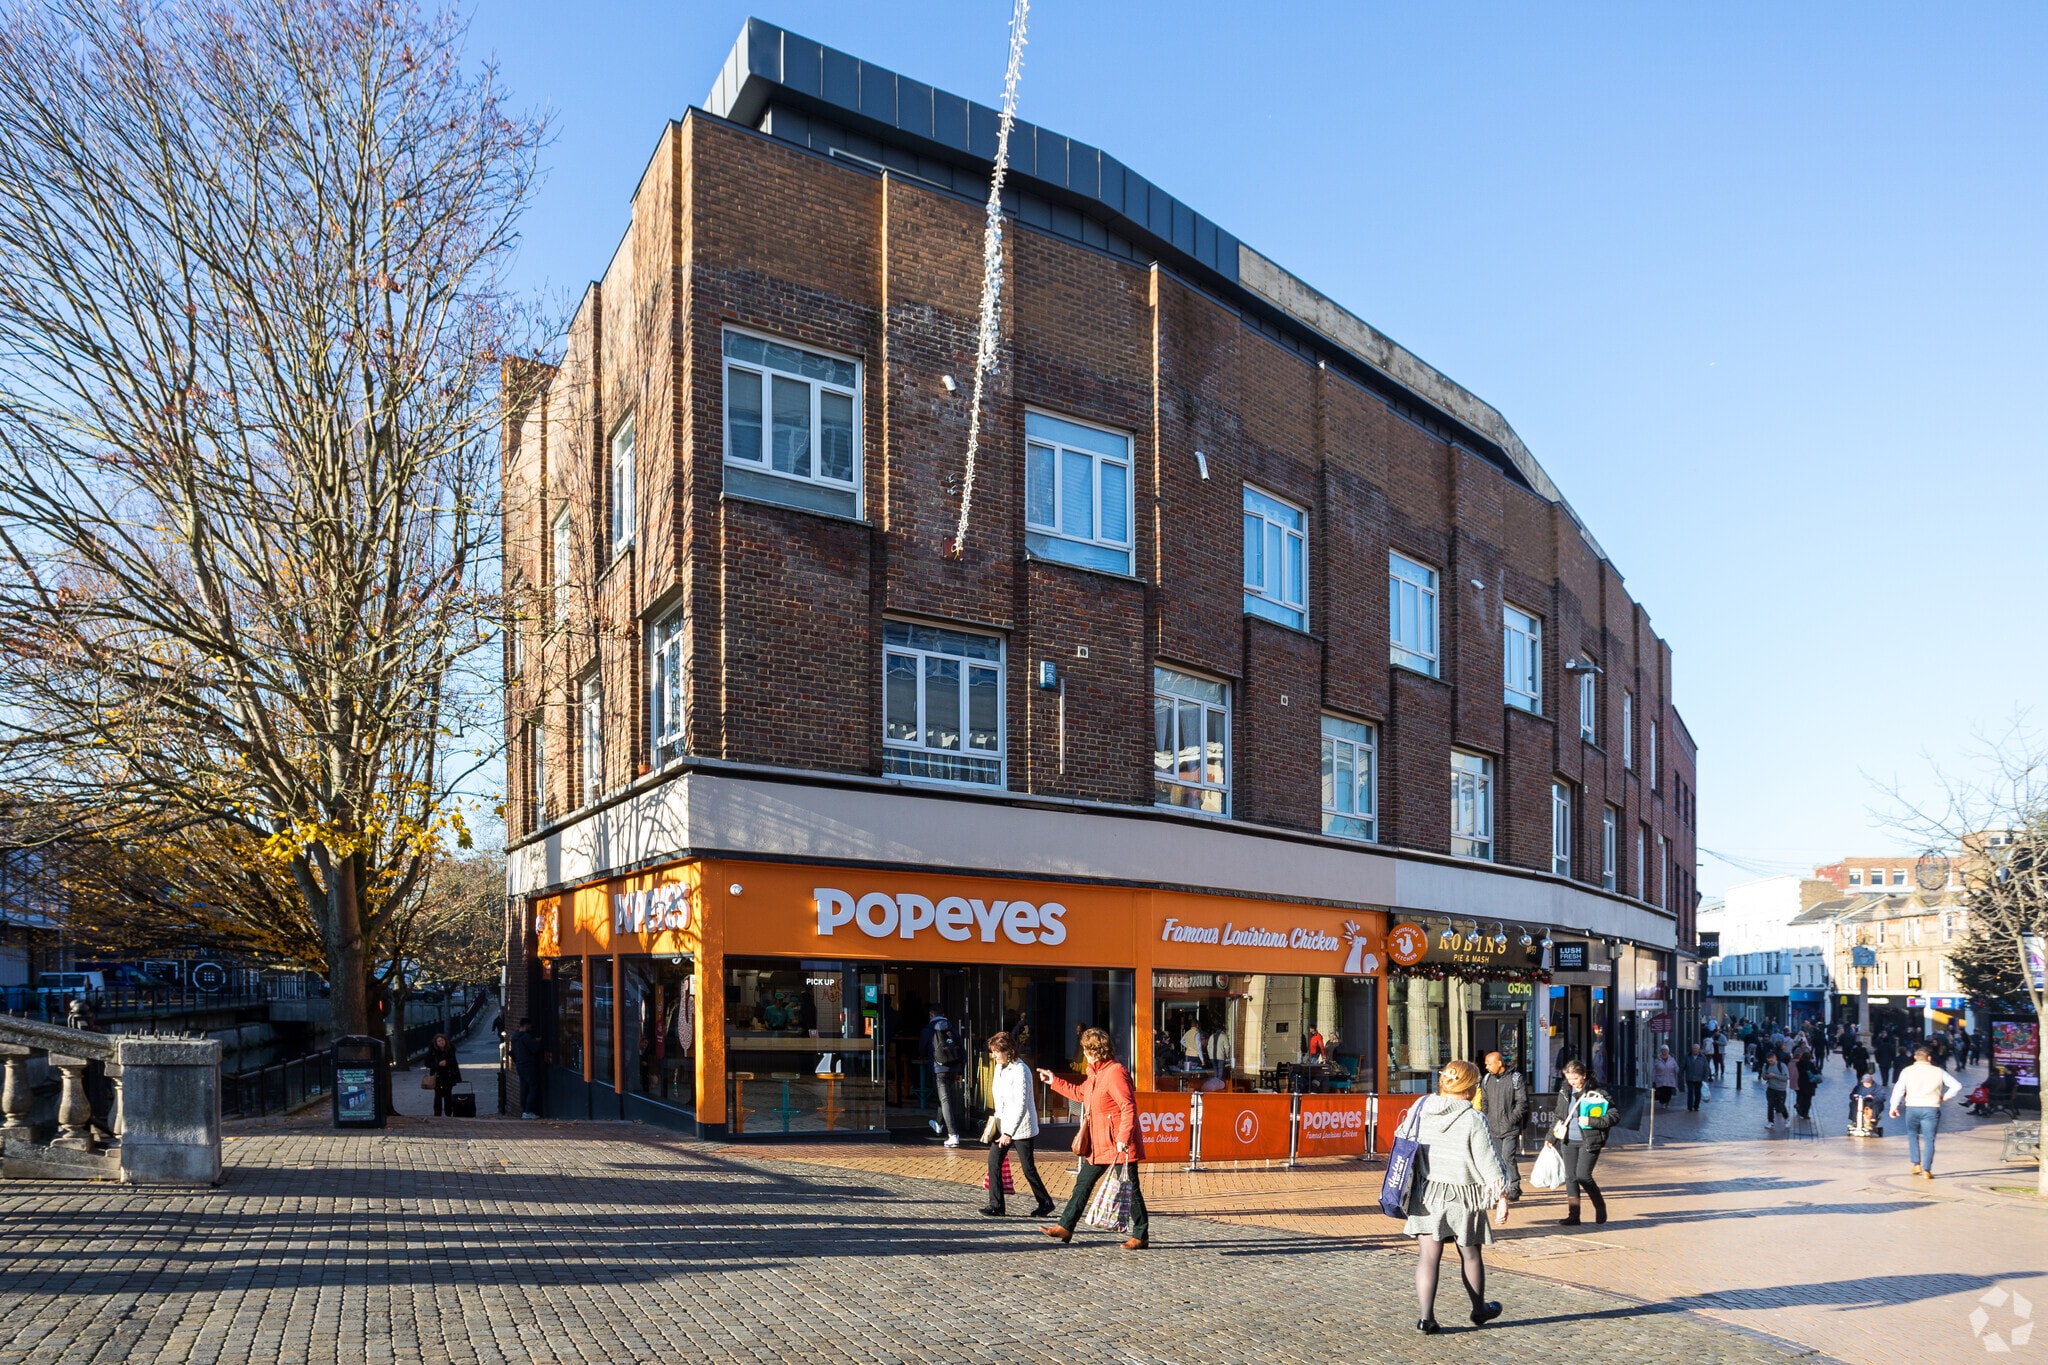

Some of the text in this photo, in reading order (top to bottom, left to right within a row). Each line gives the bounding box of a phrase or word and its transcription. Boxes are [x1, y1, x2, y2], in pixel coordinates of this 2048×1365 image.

[813, 887, 1068, 945] POPEYES
[1161, 918, 1340, 952] Famous Louisiana Chicken
[1393, 926, 1419, 938] LOUISIANA
[1394, 952, 1418, 962] KITCHEN
[1453, 953, 1490, 964] PIE & MASH
[806, 978, 835, 986] PICK UP
[1723, 980, 1768, 991] DEBENHAMS
[1138, 1111, 1186, 1132] EYES
[1303, 1110, 1362, 1130] POPEYES
[1531, 1111, 1556, 1123] ROB
[1156, 1133, 1179, 1143] Chicken
